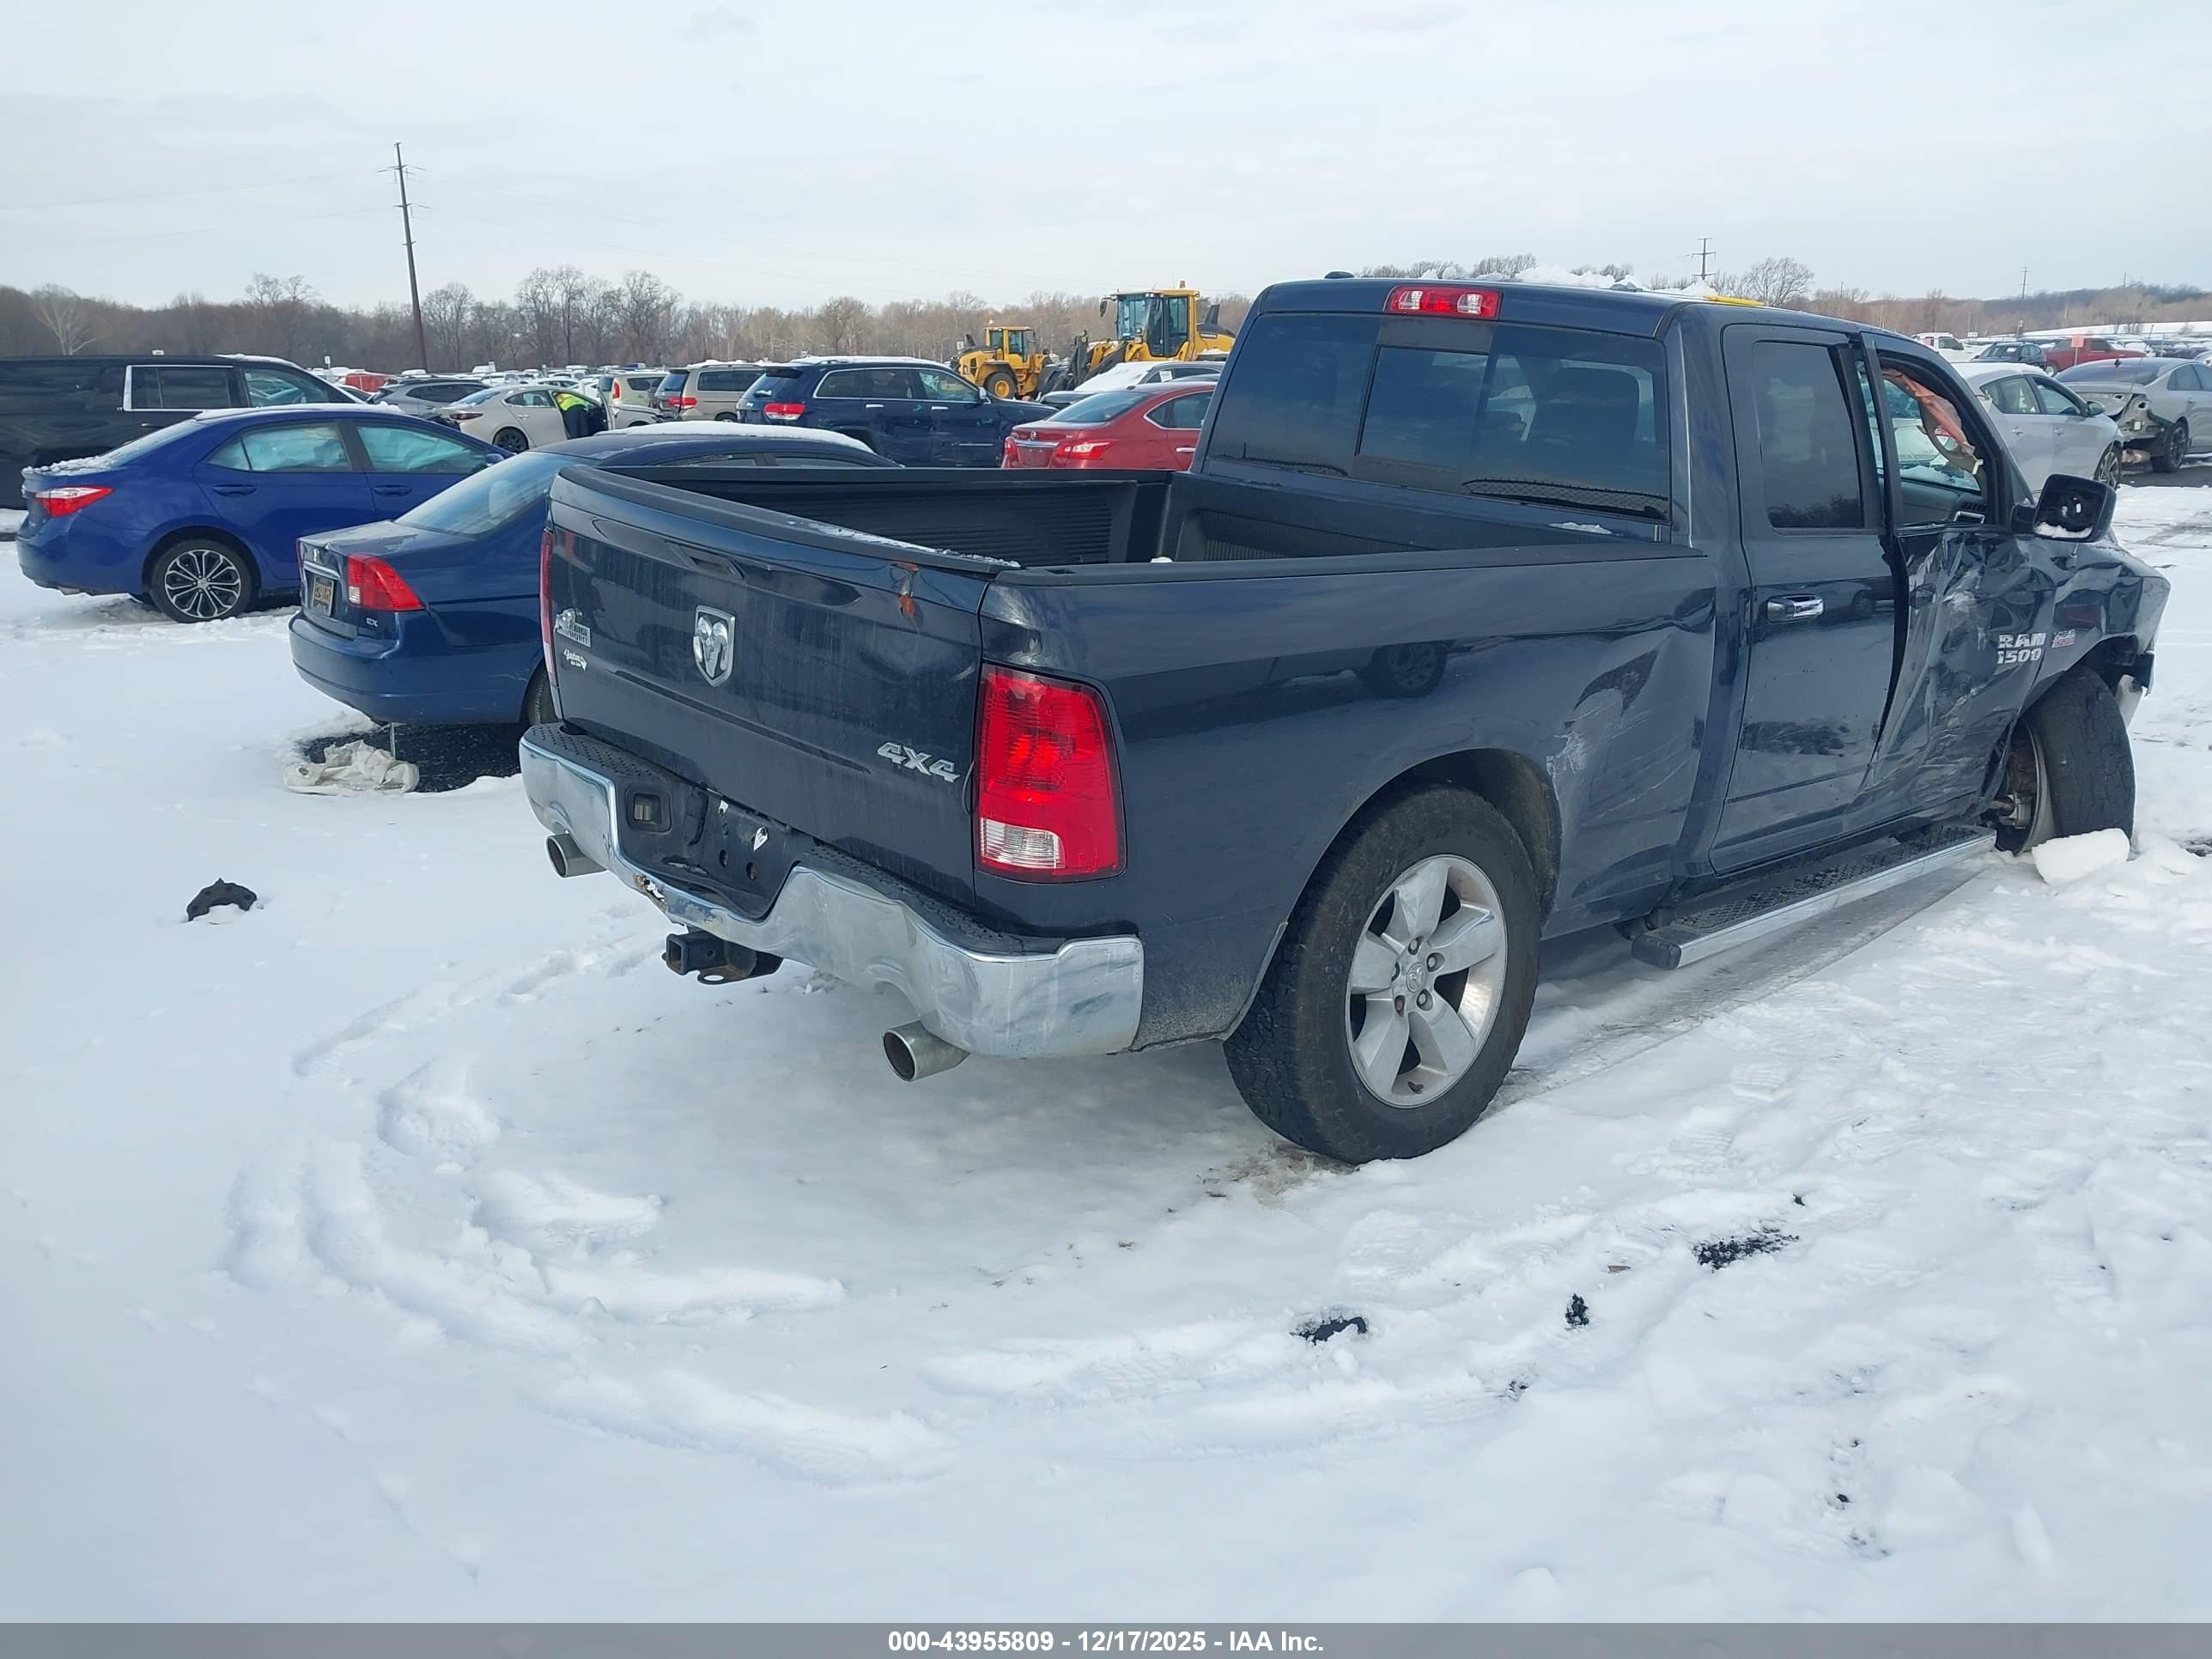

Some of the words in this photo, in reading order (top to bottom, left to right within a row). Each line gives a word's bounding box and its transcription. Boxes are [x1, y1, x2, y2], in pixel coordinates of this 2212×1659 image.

[366, 617, 379, 628] EX
[1997, 632, 2047, 649] RAM
[1996, 647, 2042, 665] 1500
